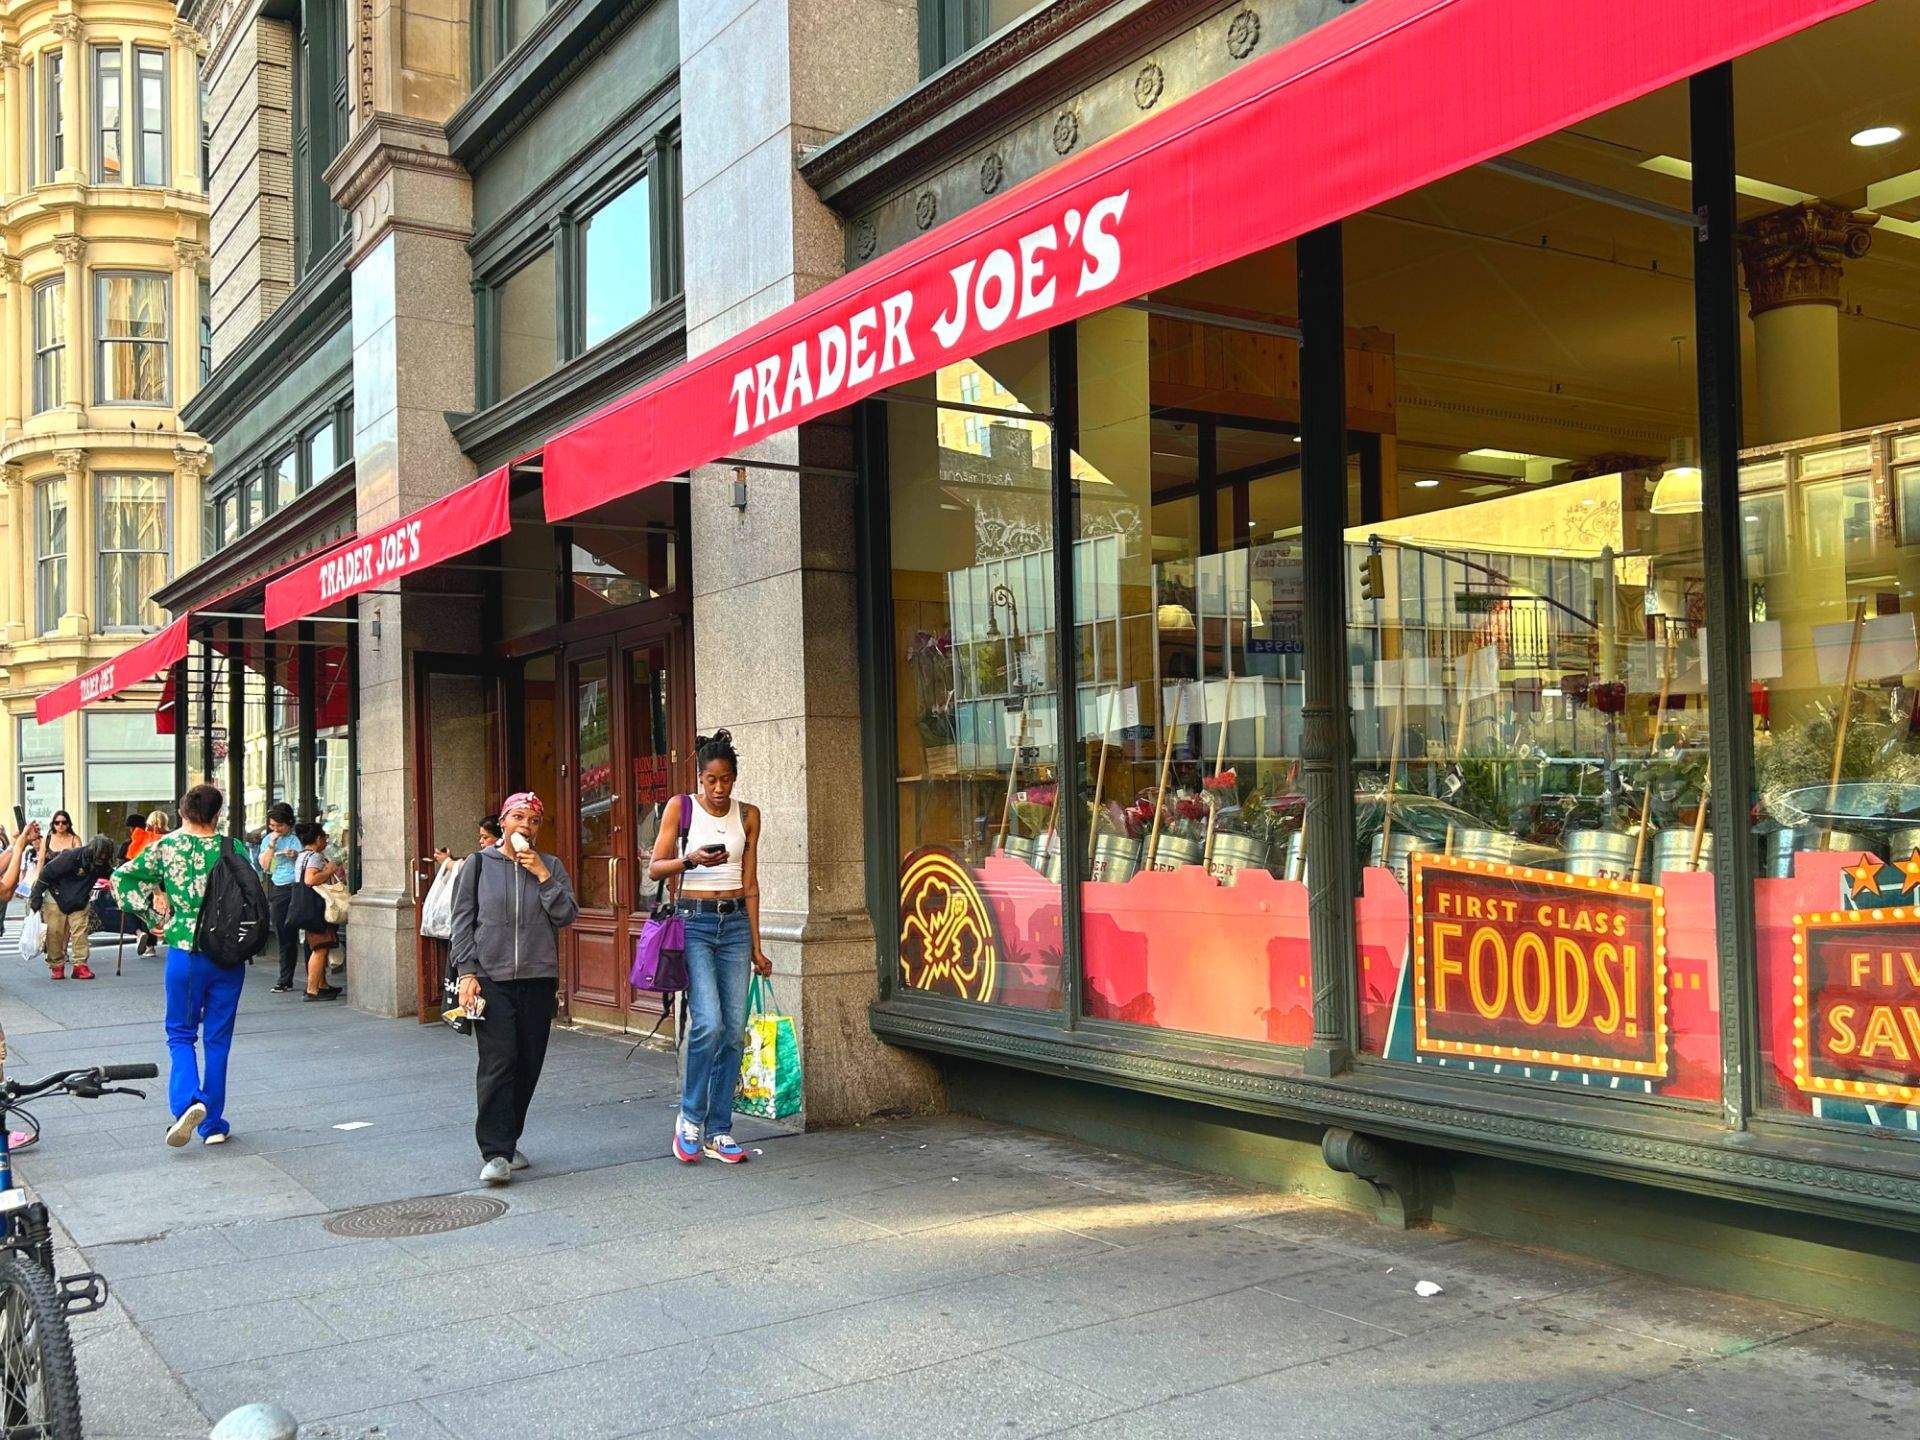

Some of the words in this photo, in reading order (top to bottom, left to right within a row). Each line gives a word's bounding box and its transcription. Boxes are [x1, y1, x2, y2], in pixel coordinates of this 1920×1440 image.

[729, 290, 915, 437] TRADER
[931, 189, 1130, 349] JOE'S
[320, 543, 373, 600] TRADER
[376, 519, 422, 576] JOE'S
[1438, 892, 1518, 923] FIRST
[1537, 905, 1627, 937] CLASS
[1432, 921, 1638, 1038] FOODS!
